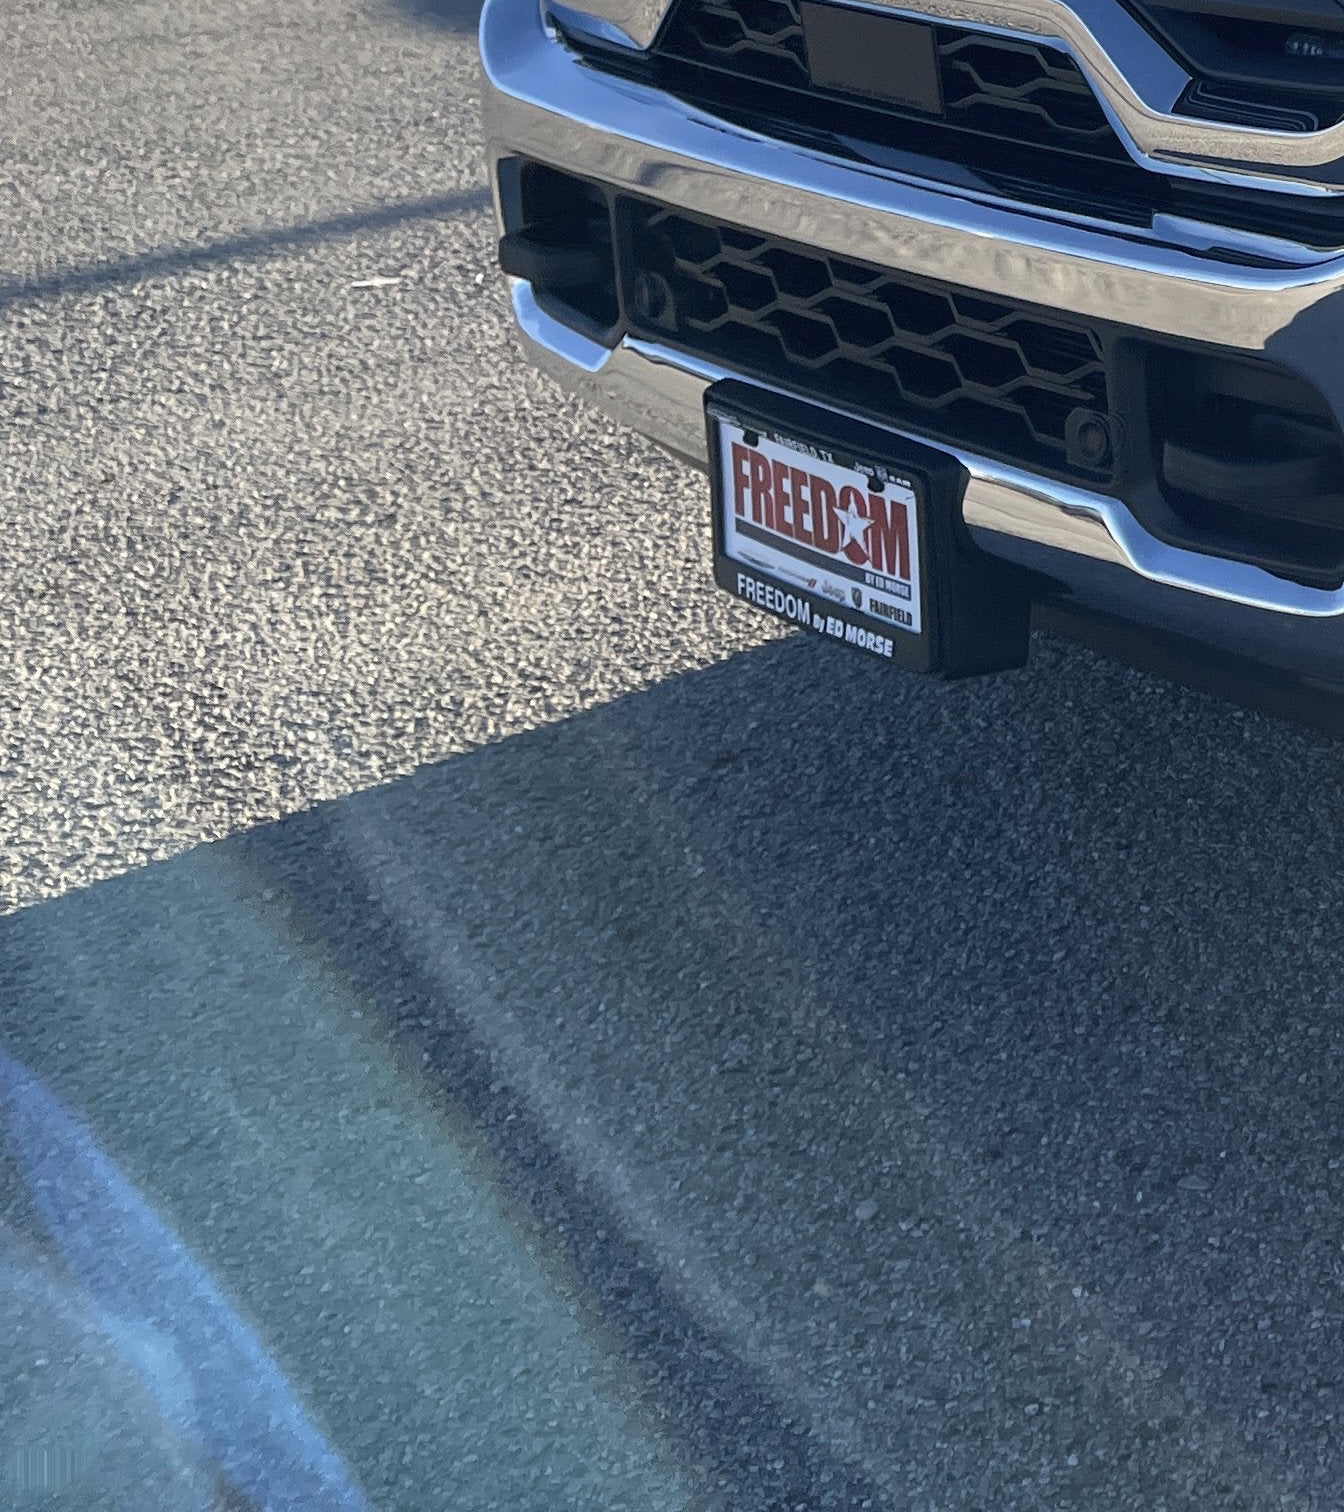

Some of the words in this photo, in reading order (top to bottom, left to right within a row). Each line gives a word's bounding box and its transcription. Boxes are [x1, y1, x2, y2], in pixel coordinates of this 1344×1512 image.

[731, 441, 911, 580] FREEDOM
[737, 572, 811, 625] FREEDOM
[826, 616, 844, 639] ED
[845, 623, 894, 658] MORSE
